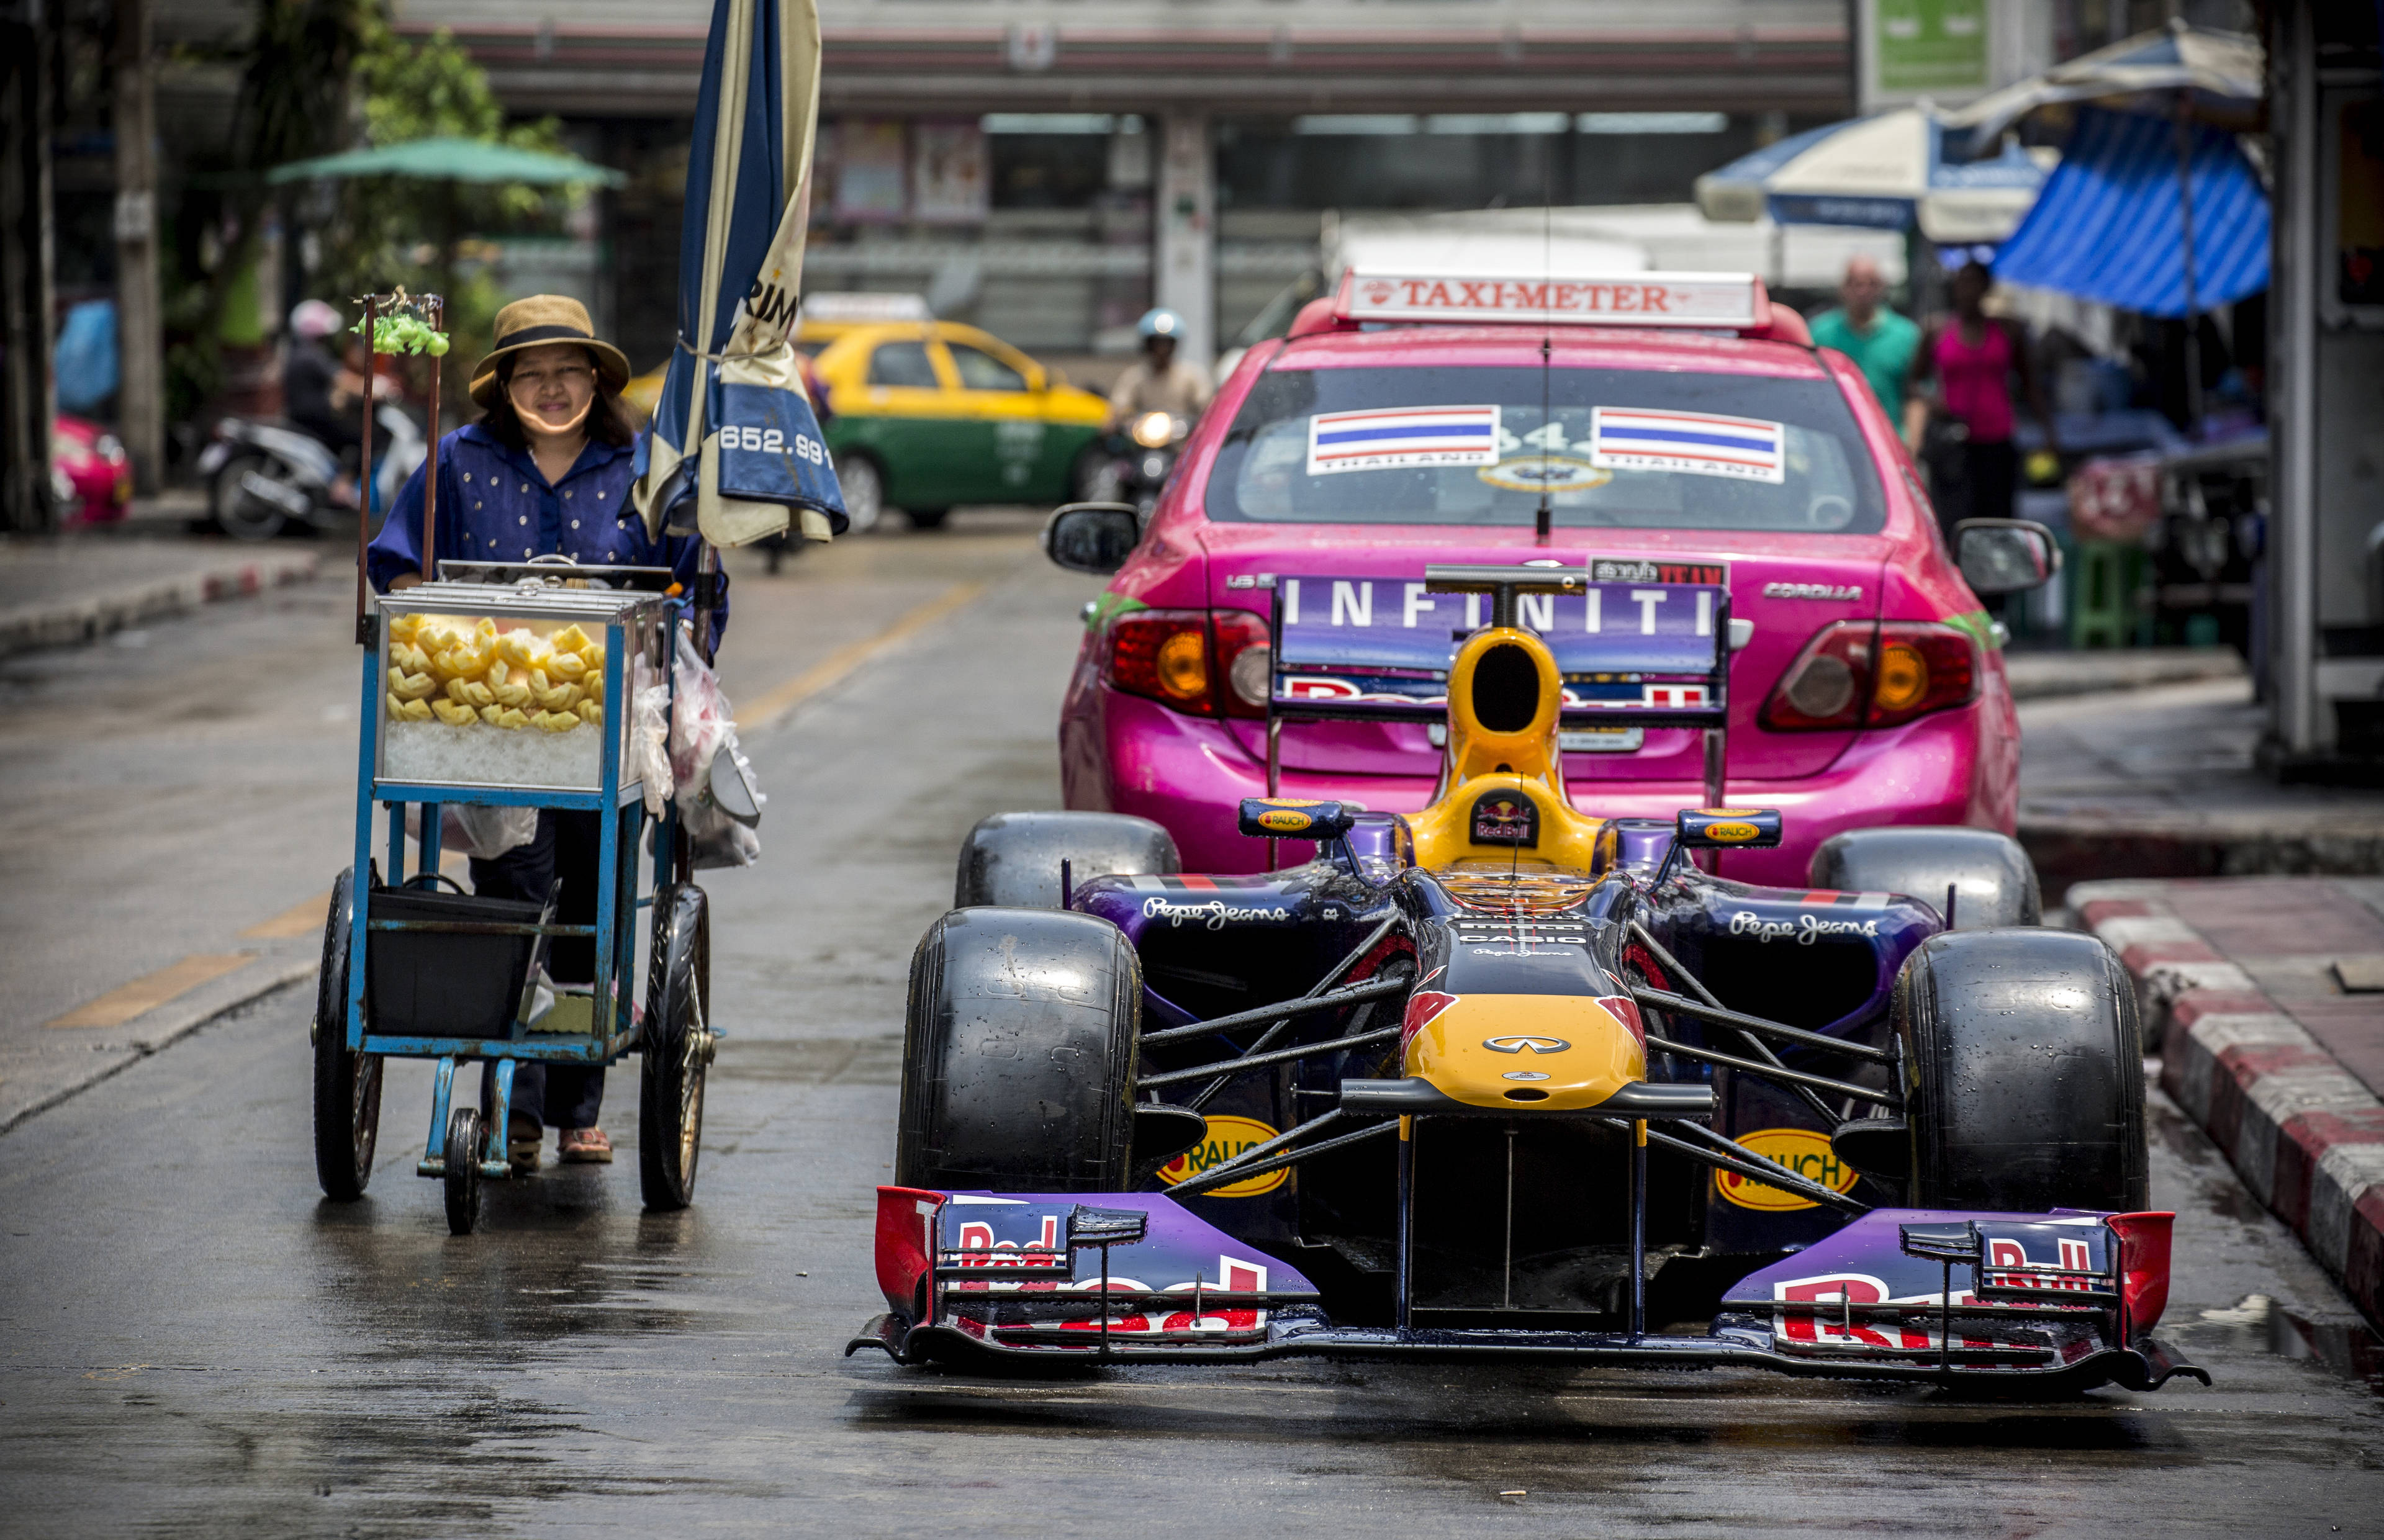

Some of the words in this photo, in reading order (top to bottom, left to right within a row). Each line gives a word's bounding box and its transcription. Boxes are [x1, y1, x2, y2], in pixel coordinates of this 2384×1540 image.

[1401, 281, 1670, 312] TAXI-METER
[1324, 453, 1484, 468] THAILAND
[1607, 456, 1770, 477] THAILAND
[1285, 579, 1712, 636] INFINITI
[1273, 816, 1304, 826] RAUCH
[1476, 822, 1503, 837] Red
[1504, 824, 1530, 839] Bull
[1720, 827, 1752, 836] RAUCH
[1143, 897, 1206, 927] Pepe
[1207, 901, 1290, 930] Jeans
[1729, 911, 1796, 943] Pepe
[1797, 914, 1879, 945] Jeans
[1459, 935, 1587, 943] CASIO
[1473, 948, 1517, 957] Pepe
[1517, 949, 1574, 957] Jeans
